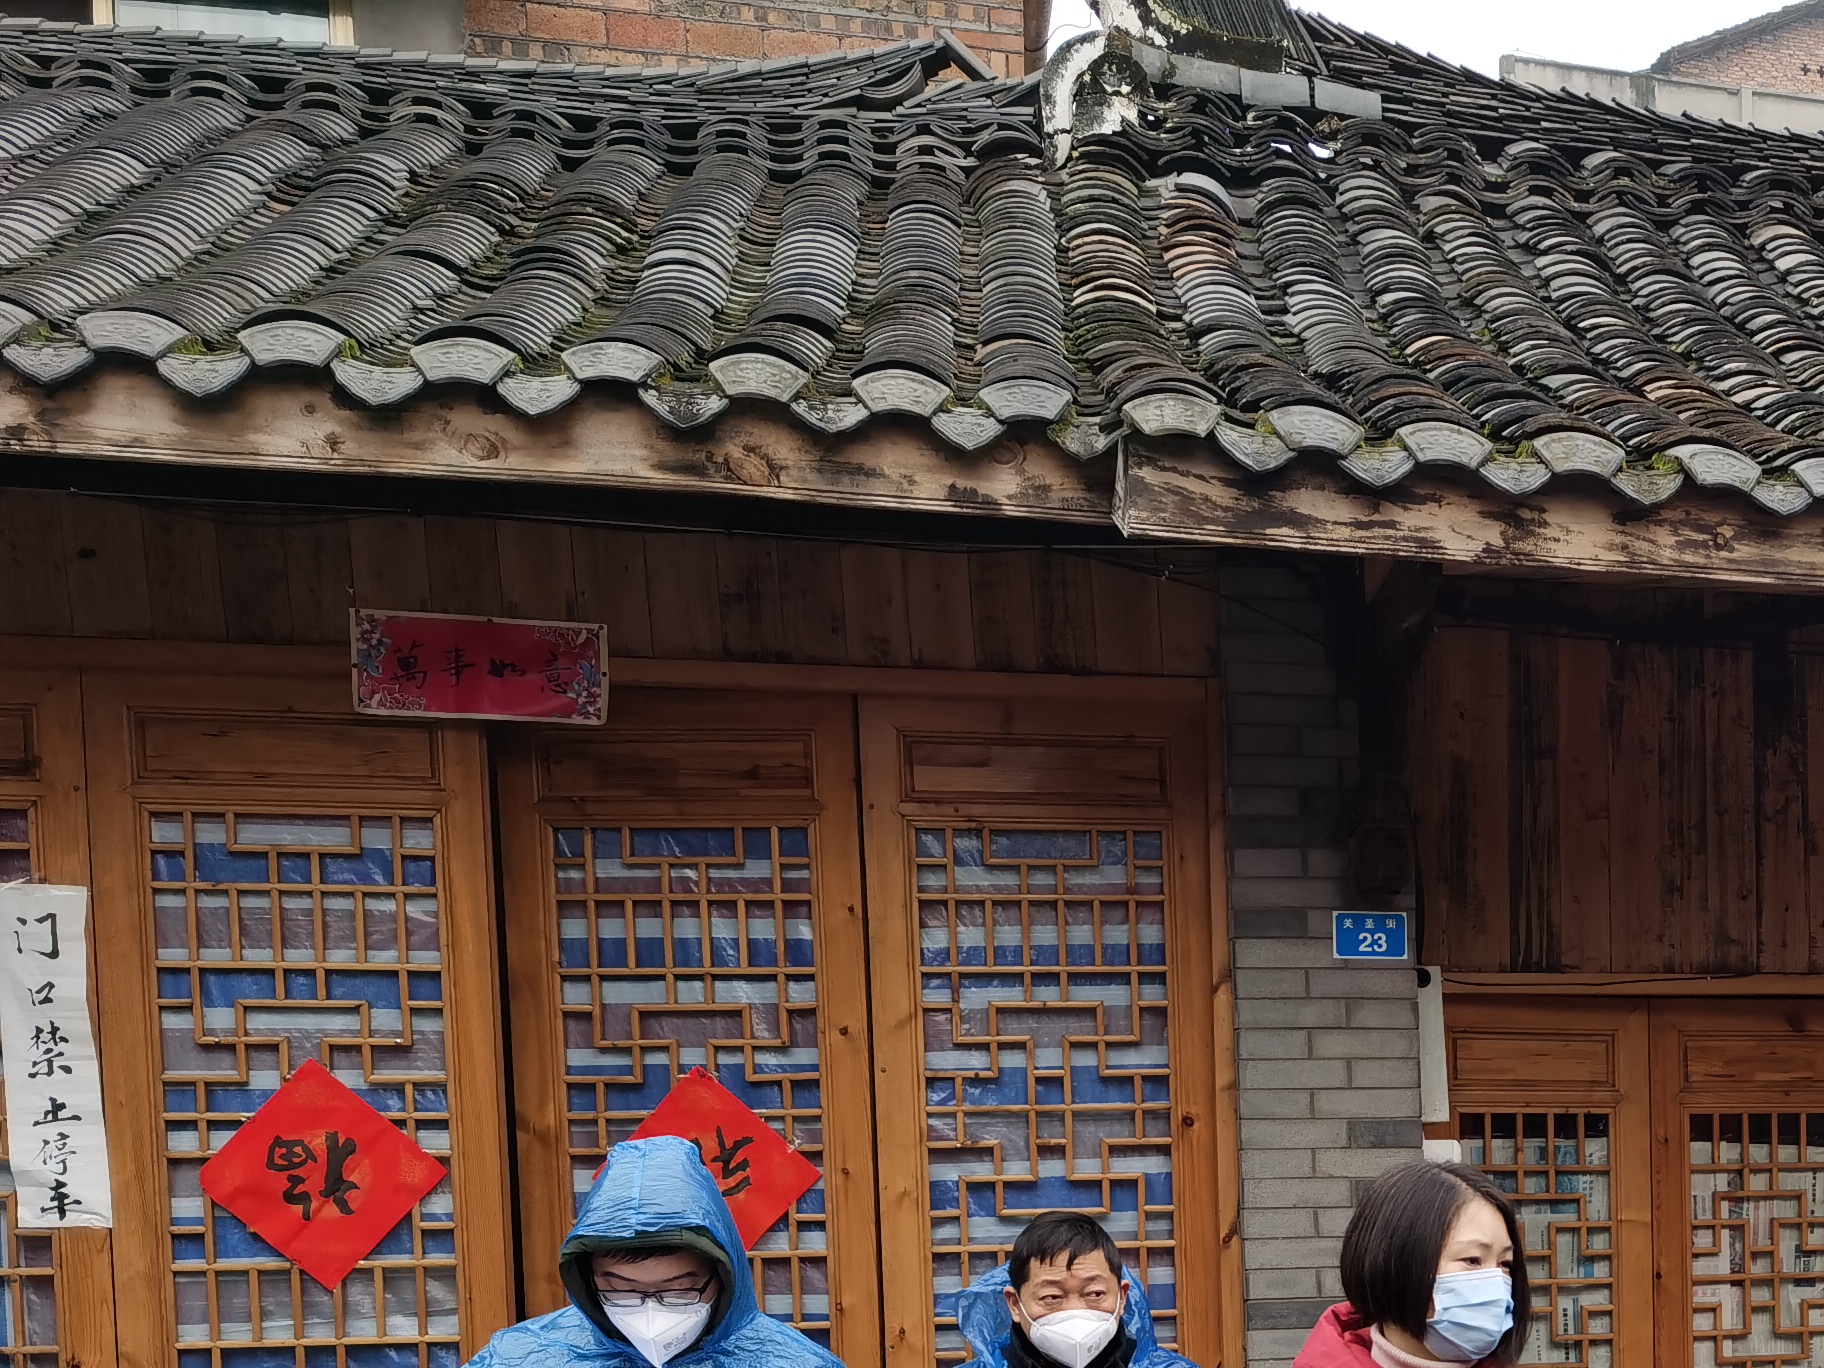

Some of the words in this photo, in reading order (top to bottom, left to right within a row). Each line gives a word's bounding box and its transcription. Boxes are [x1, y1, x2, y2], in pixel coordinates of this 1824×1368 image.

[390, 639, 574, 694] 萬事如意
[1358, 932, 1388, 952] 23
[13, 912, 83, 1222] 门口禁止停车
[266, 1131, 360, 1222] 福
